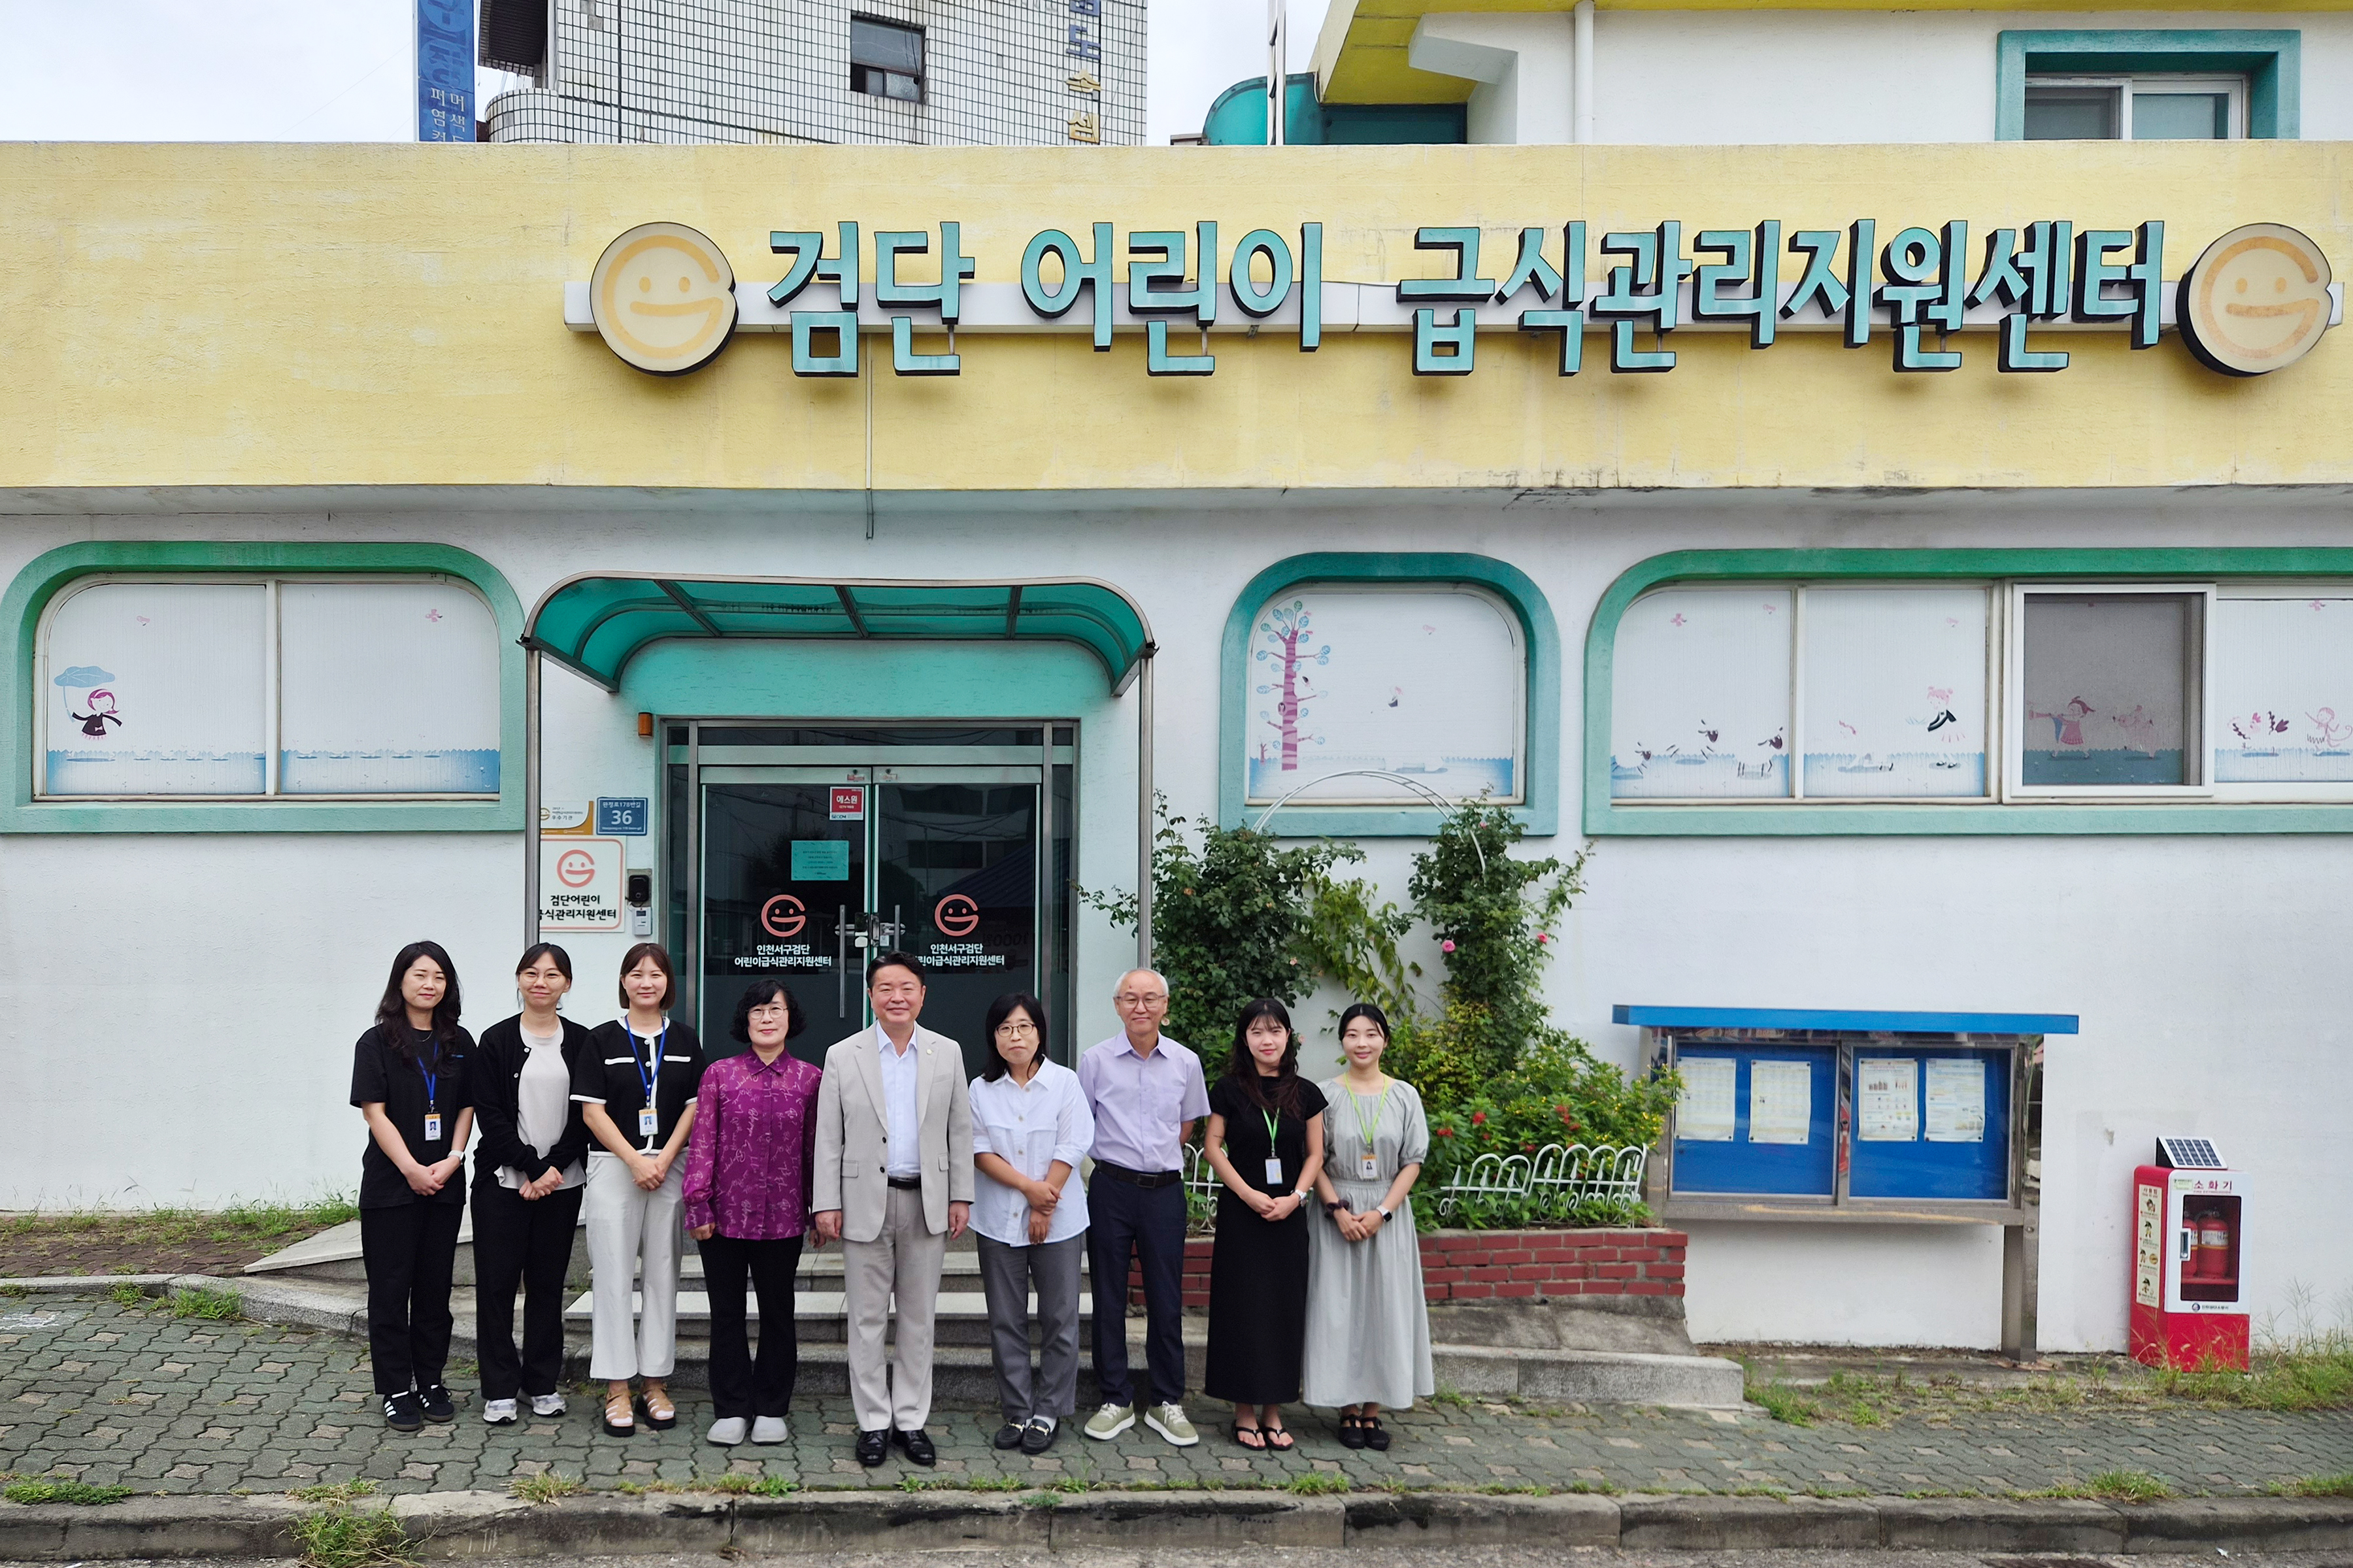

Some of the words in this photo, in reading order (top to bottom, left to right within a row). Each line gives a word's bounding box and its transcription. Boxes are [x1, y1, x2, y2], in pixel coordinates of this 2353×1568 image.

[431, 108, 466, 133] 염색
[766, 220, 976, 378] 검단
[1020, 220, 1323, 378] 어린이
[1395, 218, 2165, 378] 급식관리지원센터
[836, 795, 858, 805] 에스원
[611, 810, 632, 825] 36
[550, 895, 600, 907] 검단어린이
[756, 944, 810, 955] 인천서구검단
[930, 943, 984, 954] 인천서구검단
[734, 956, 831, 967] 어린이급식관리지원센터
[915, 955, 1005, 967] 린이급식관리지원센터
[2194, 1180, 2233, 1191] 소화기
